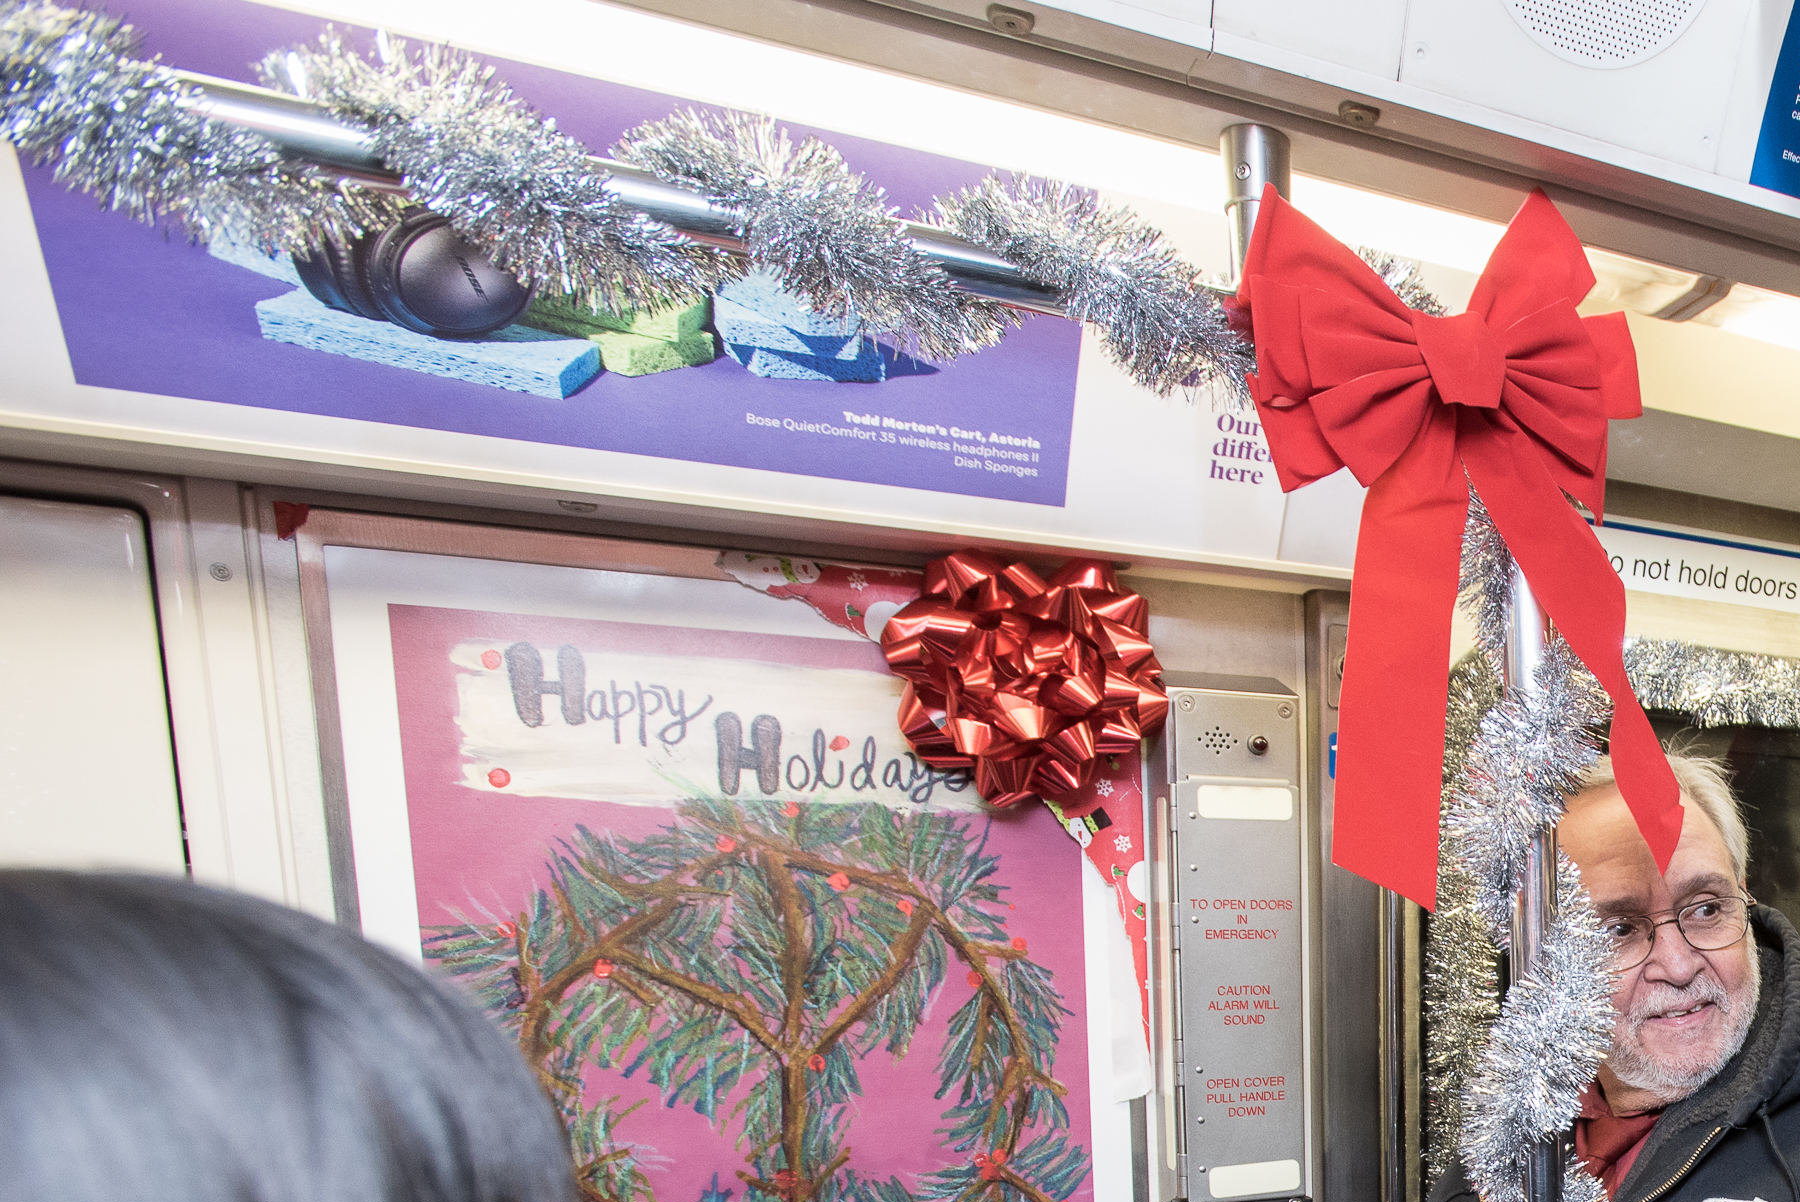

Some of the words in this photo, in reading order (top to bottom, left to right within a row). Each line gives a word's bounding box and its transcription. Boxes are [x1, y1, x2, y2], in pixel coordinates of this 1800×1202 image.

[842, 410, 881, 428] Todd
[881, 416, 948, 437] Morton's
[949, 425, 987, 443] Cart,
[988, 431, 1041, 450] Astoria
[1217, 413, 1263, 436] Our
[745, 412, 781, 428] Bose
[782, 417, 878, 442] QuietComfort
[878, 430, 897, 444] 35
[898, 433, 951, 452] wireless
[952, 440, 1029, 465] headphones
[1212, 437, 1272, 463] diffe
[953, 455, 982, 470] Dish
[984, 459, 1039, 478] Sponges
[1209, 459, 1264, 485] here
[1604, 548, 1624, 574] o
[1633, 557, 1671, 582] not
[1678, 559, 1729, 590] hold
[1735, 569, 1798, 600] doors
[505, 641, 713, 746] Happy
[1190, 898, 1209, 910] TO
[1212, 898, 1246, 910] OPEN
[1250, 899, 1293, 911] DOORS
[1236, 914, 1248, 925] IN
[1205, 929, 1279, 940] EMERGENCY
[1217, 985, 1271, 996] CAUTION
[1207, 1000, 1249, 1011] ALARM
[1253, 999, 1280, 1010] WILL
[1223, 1014, 1266, 1026] SOUND
[1206, 1078, 1240, 1090] OPEN
[1243, 1076, 1285, 1088] COVER
[1206, 1093, 1235, 1104] PULL
[1239, 1090, 1285, 1102] HANDLE
[1228, 1106, 1266, 1118] DOWN
